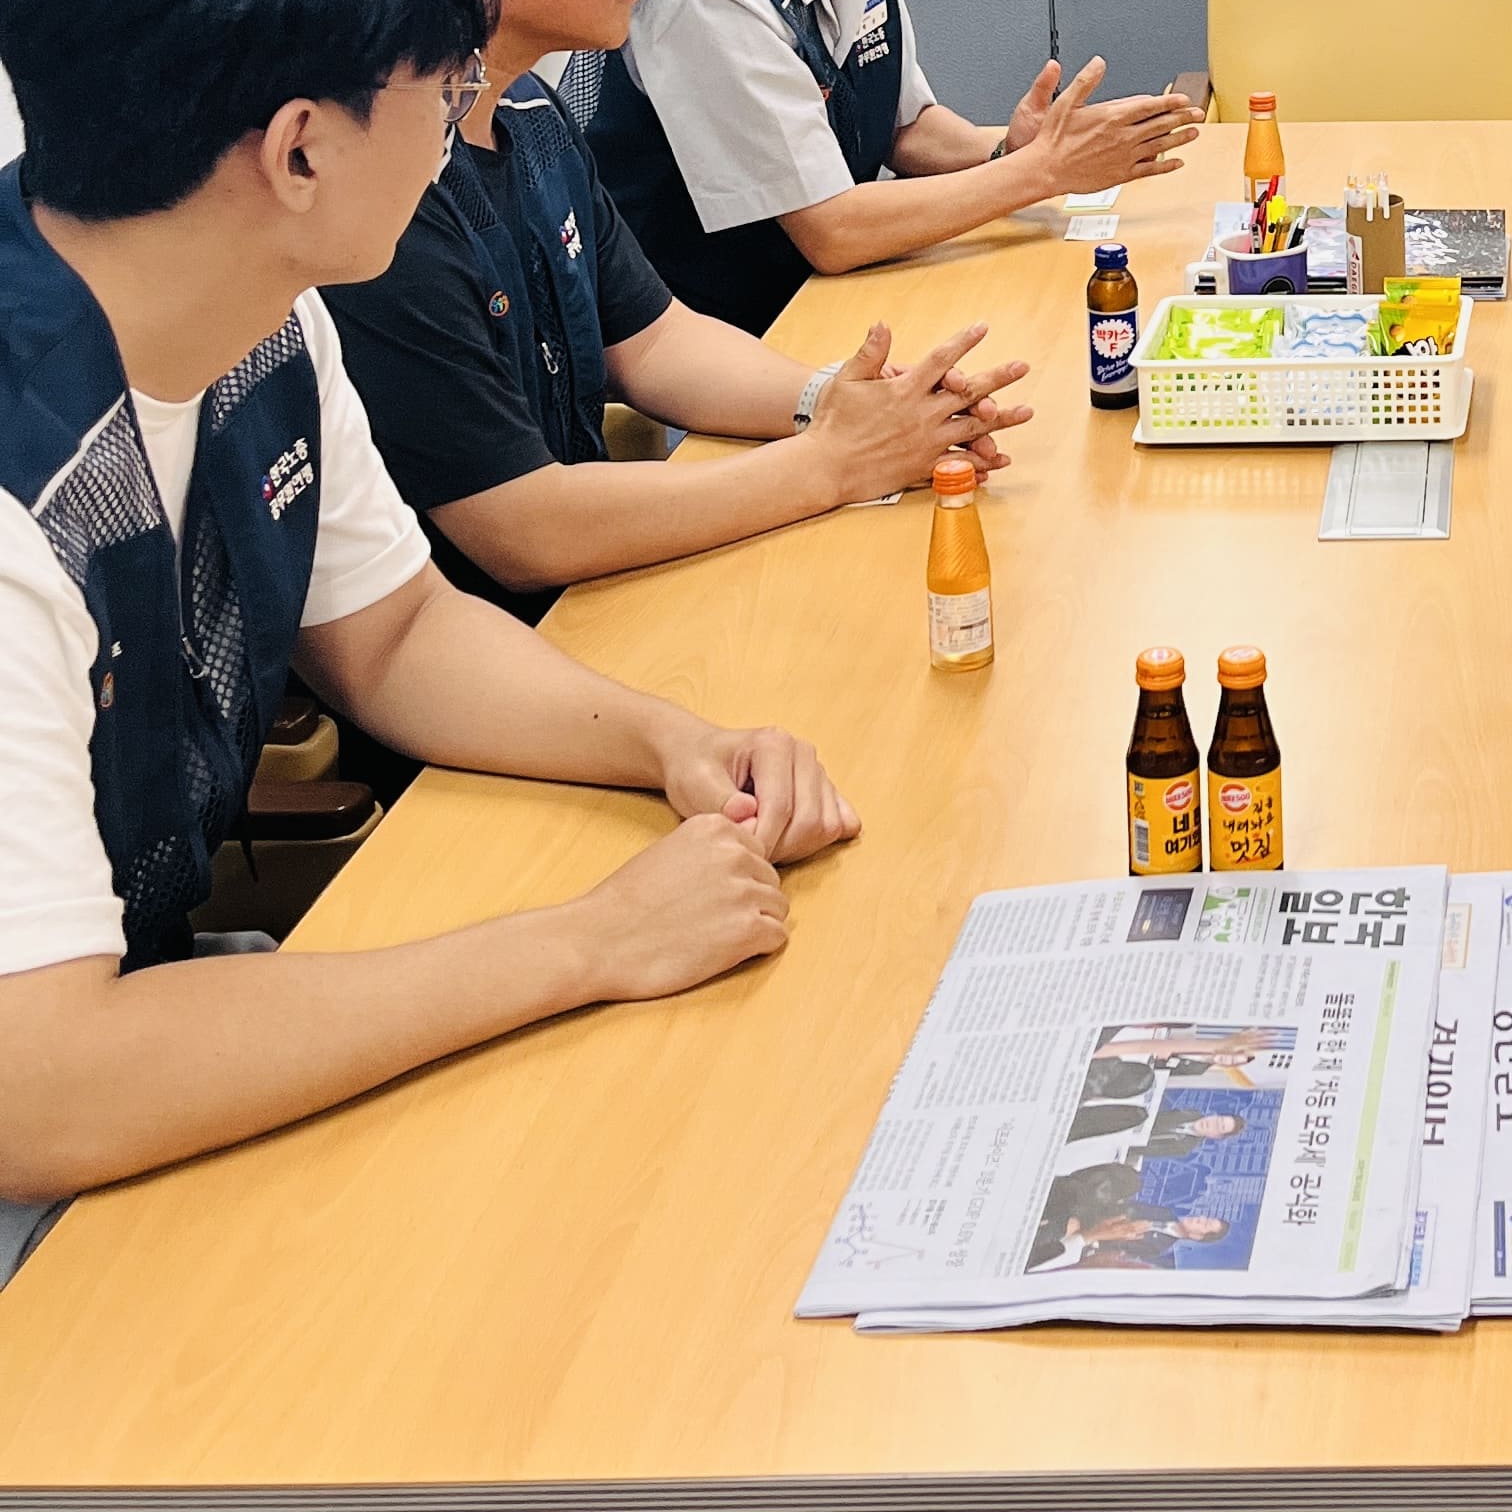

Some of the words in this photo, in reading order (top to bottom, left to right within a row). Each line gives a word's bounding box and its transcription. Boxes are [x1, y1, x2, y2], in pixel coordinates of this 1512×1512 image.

[1351, 261, 1359, 295] DAEG
[1096, 330, 1130, 342] 박카스
[1110, 343, 1118, 352] F
[1230, 831, 1272, 865] 멋짐
[1279, 889, 1344, 946] 일보
[1344, 887, 1411, 949] 한국
[1320, 992, 1355, 1035] 똘똘한
[1316, 1038, 1347, 1053] 한
[1282, 1172, 1323, 1226] 공식화
